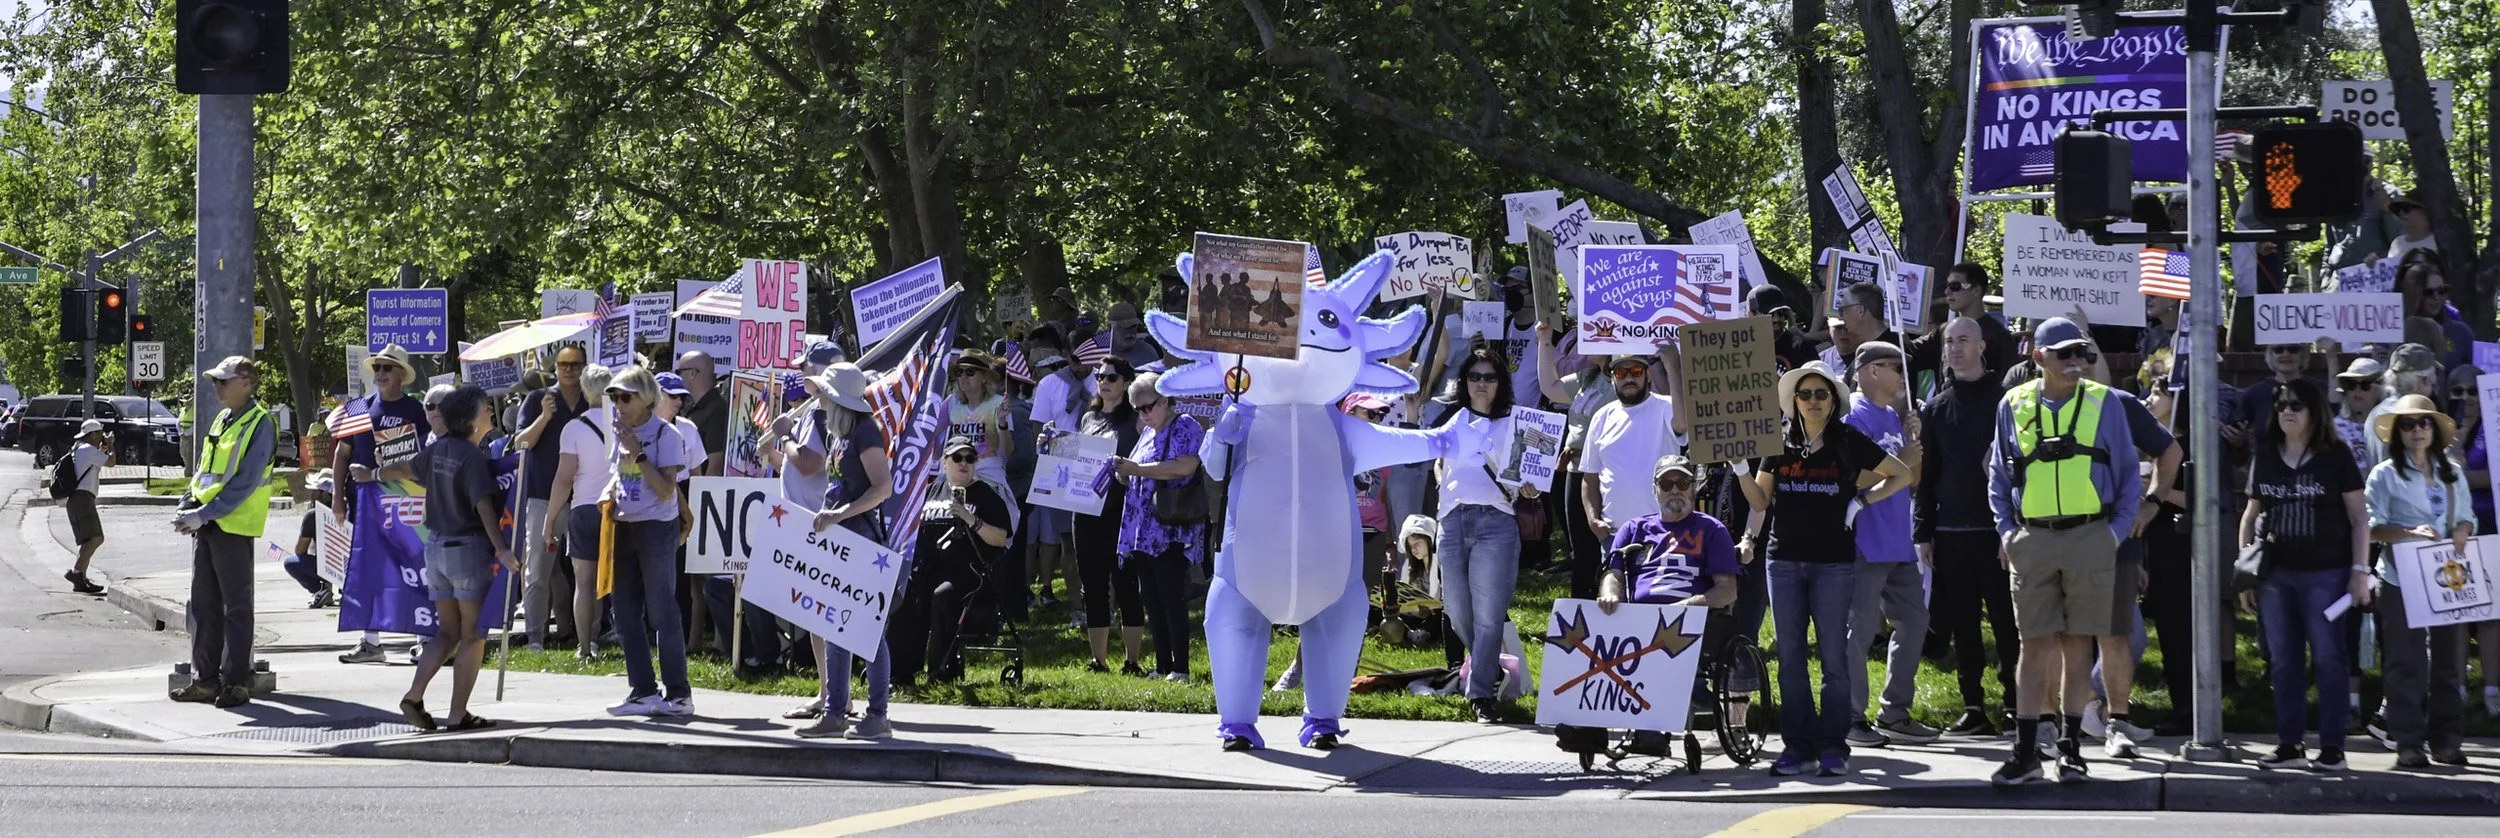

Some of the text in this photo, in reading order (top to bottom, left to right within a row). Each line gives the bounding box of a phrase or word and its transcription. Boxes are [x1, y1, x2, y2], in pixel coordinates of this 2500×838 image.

[1997, 88, 2161, 121] NO KINGS
[2343, 87, 2378, 105] DO
[1983, 118, 2180, 150] IN AMICA
[1547, 207, 1589, 250] BEFORE
[1719, 224, 1746, 243] TRUST
[2039, 227, 2048, 243] I
[1237, 241, 1265, 251] Grandfather
[1377, 236, 1401, 255] We
[2017, 246, 2134, 263] BE REMEMBERED AS
[1396, 252, 1454, 272] for less
[1586, 250, 1643, 277] We are
[1688, 256, 1721, 265] REJECTING
[9, 271, 28, 280] Ave
[1595, 255, 1652, 289] united
[1695, 274, 1712, 282] 1776
[2011, 264, 2129, 283] A WOMAN WHO KEPT
[755, 260, 800, 312] WE
[860, 271, 936, 311] Stop the billionaire
[1601, 273, 1663, 305] against
[2021, 283, 2121, 306] HER MOUTH SHUT
[372, 296, 442, 309] Tourist Information
[861, 284, 940, 324] takeover corrupting
[1621, 288, 1673, 314] Kings
[372, 314, 442, 327] Chamber of Commerce
[694, 313, 731, 325] Kings!!!
[871, 299, 934, 333] our governme
[2257, 303, 2401, 332] SILENCE VIOLENCE
[372, 332, 420, 345] 2157 First St
[678, 331, 732, 346] Queens???
[1208, 328, 1221, 336] And
[1221, 329, 1232, 337] not
[1232, 329, 1247, 338] what
[1251, 331, 1268, 340] stand
[1622, 325, 1645, 337] NO
[1688, 326, 1756, 350] They got
[737, 319, 805, 369] RULE
[138, 362, 159, 377] 30
[1692, 351, 1753, 373] MONEY
[1688, 371, 1773, 396] FOR WARS
[1696, 395, 1763, 418] but can't
[1518, 410, 1545, 425] LONG
[1542, 423, 1562, 436] MAY
[1694, 417, 1775, 442] FEED THE
[1524, 452, 1543, 464] SHE
[1713, 440, 1757, 460] POOR
[1521, 462, 1551, 478] STAND
[1791, 481, 1808, 492] had
[1809, 482, 1840, 496] enough
[806, 532, 851, 563] SAVE
[723, 559, 748, 571] KINGS
[773, 549, 886, 622] DEMOCRACY!
[791, 587, 852, 633] VOTE!
[1589, 634, 1642, 677] NO
[1579, 678, 1645, 715] KINGS
